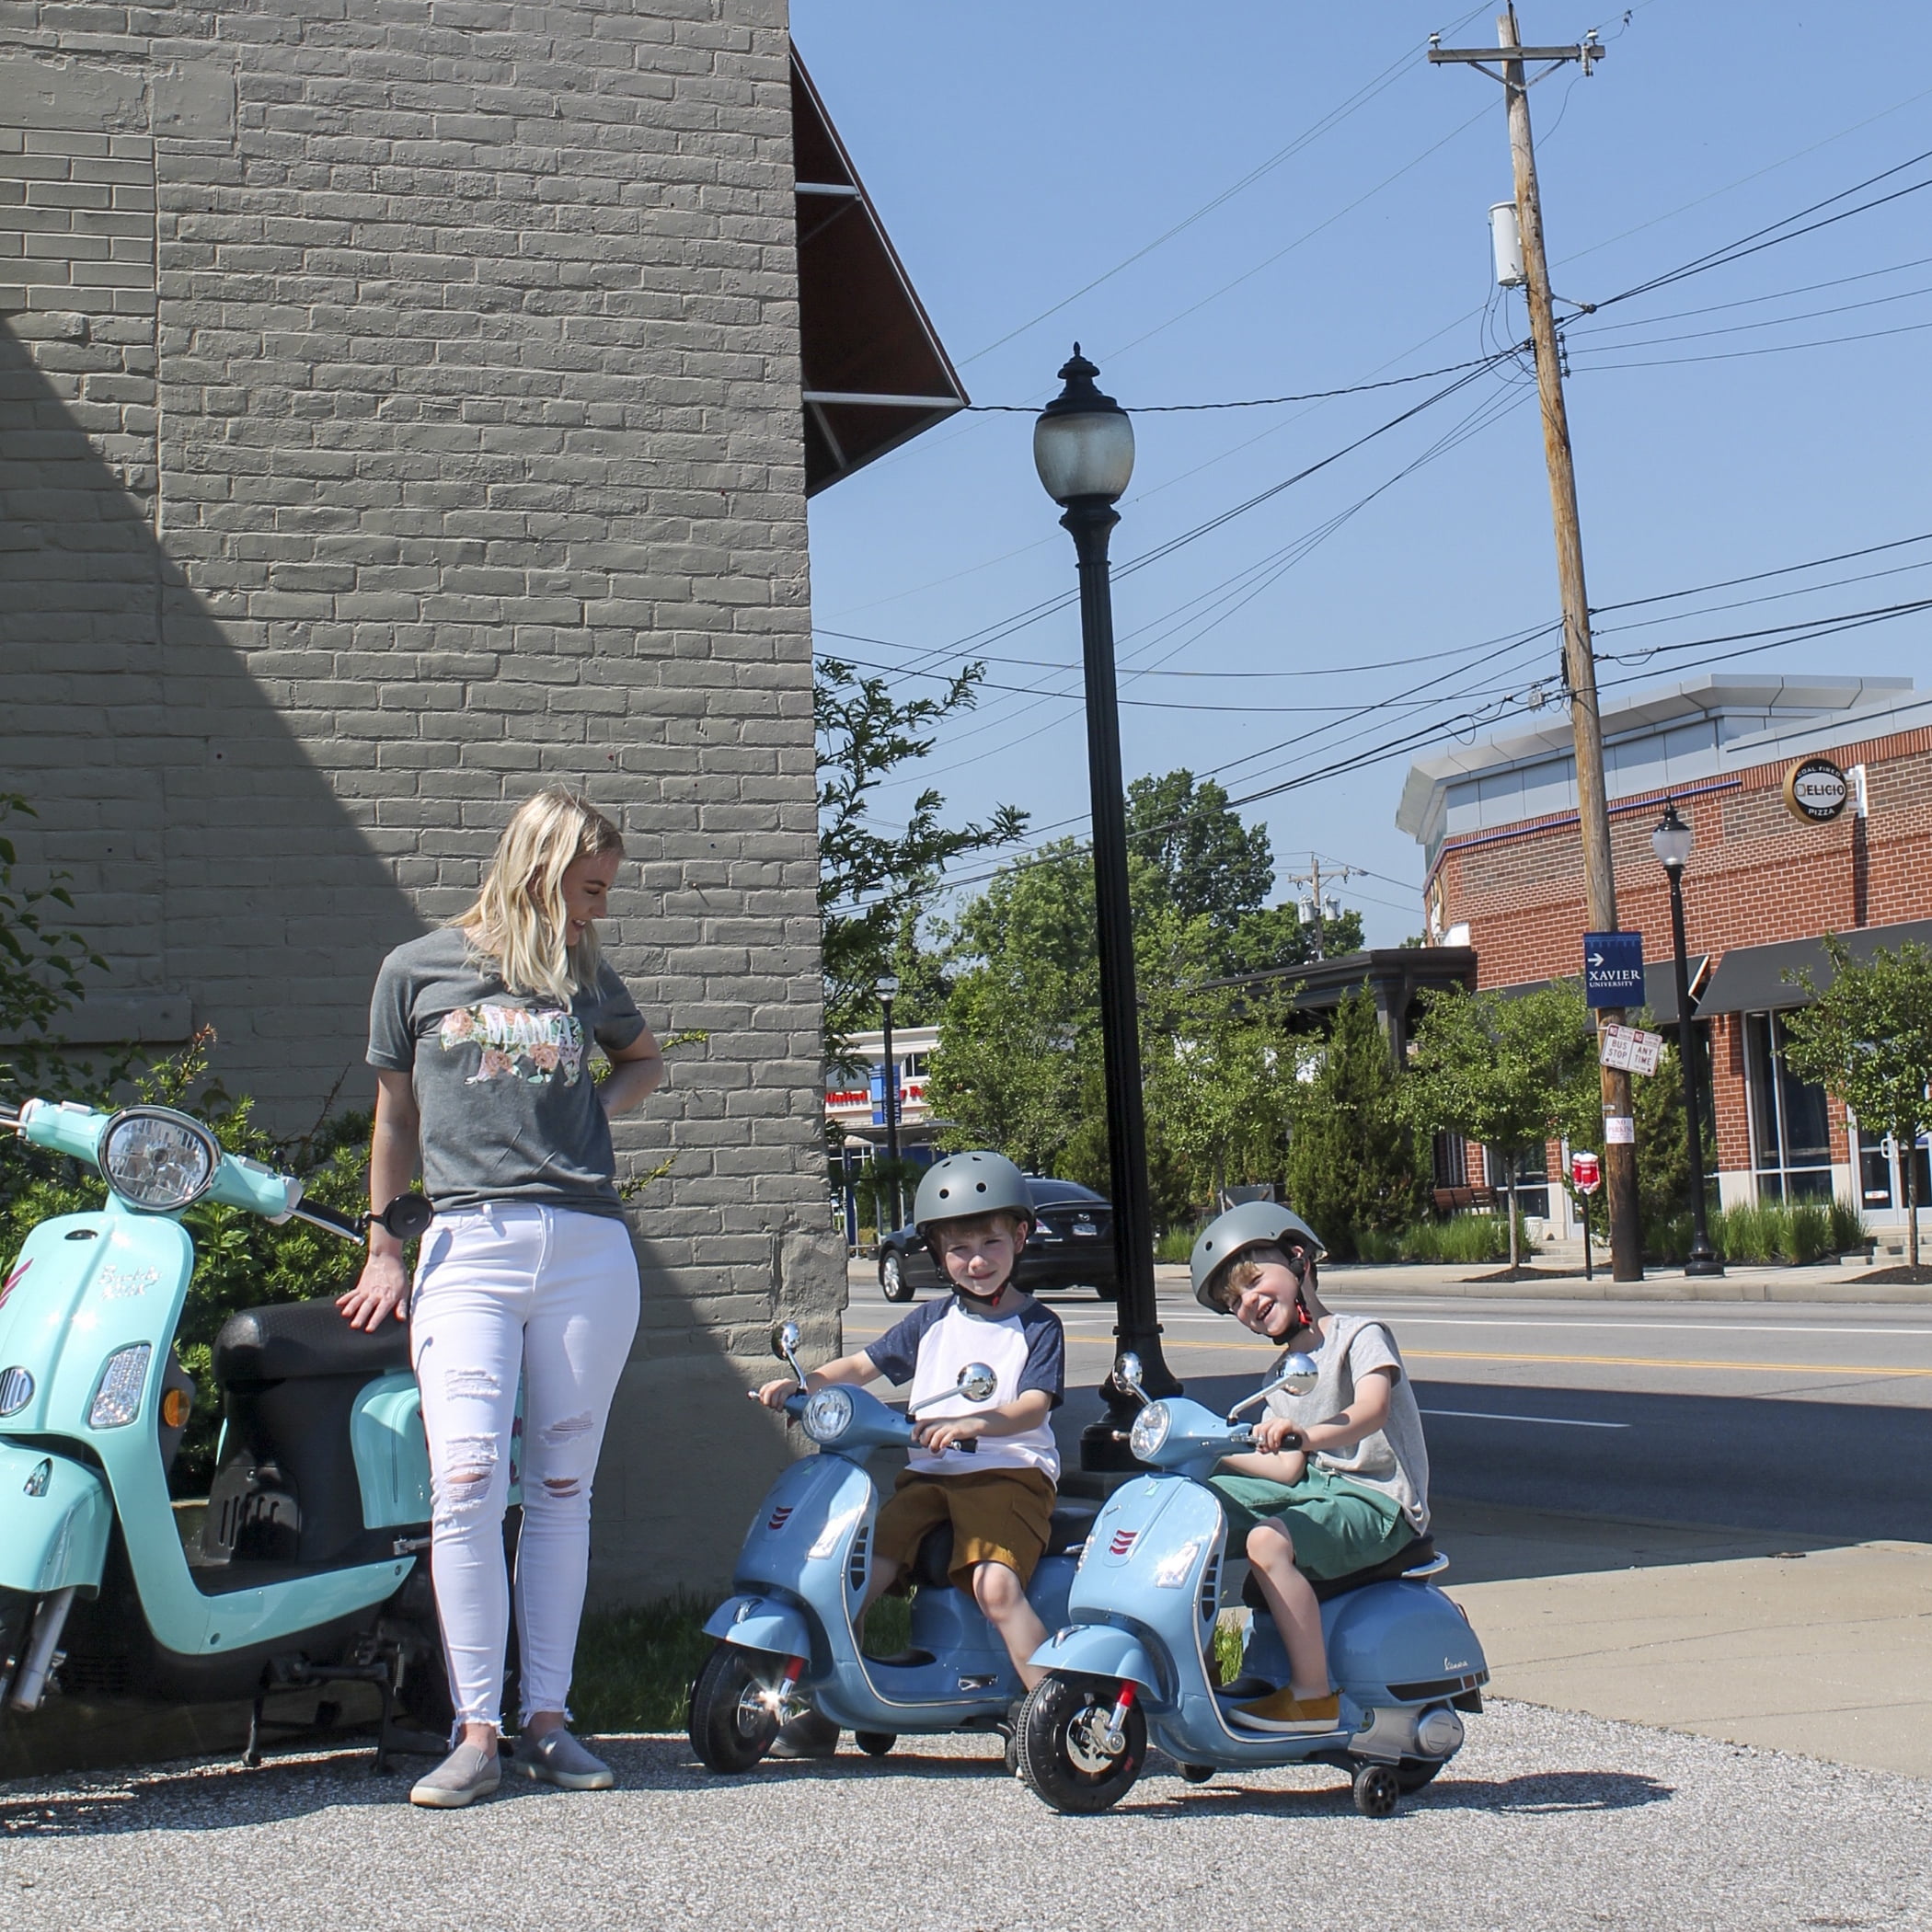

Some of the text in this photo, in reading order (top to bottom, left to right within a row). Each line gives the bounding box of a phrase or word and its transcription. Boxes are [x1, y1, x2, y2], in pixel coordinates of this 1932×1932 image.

[1797, 765, 1841, 777] COAL FIRED
[1795, 783, 1845, 797] DELICIO
[1808, 808, 1835, 816] PIZZA
[1589, 970, 1640, 981] XAVIER
[1612, 1040, 1627, 1050] BUS
[1607, 1048, 1627, 1059] STOP
[1638, 1046, 1653, 1056] ANY
[1635, 1054, 1652, 1066] TIME
[825, 1090, 868, 1102] United
